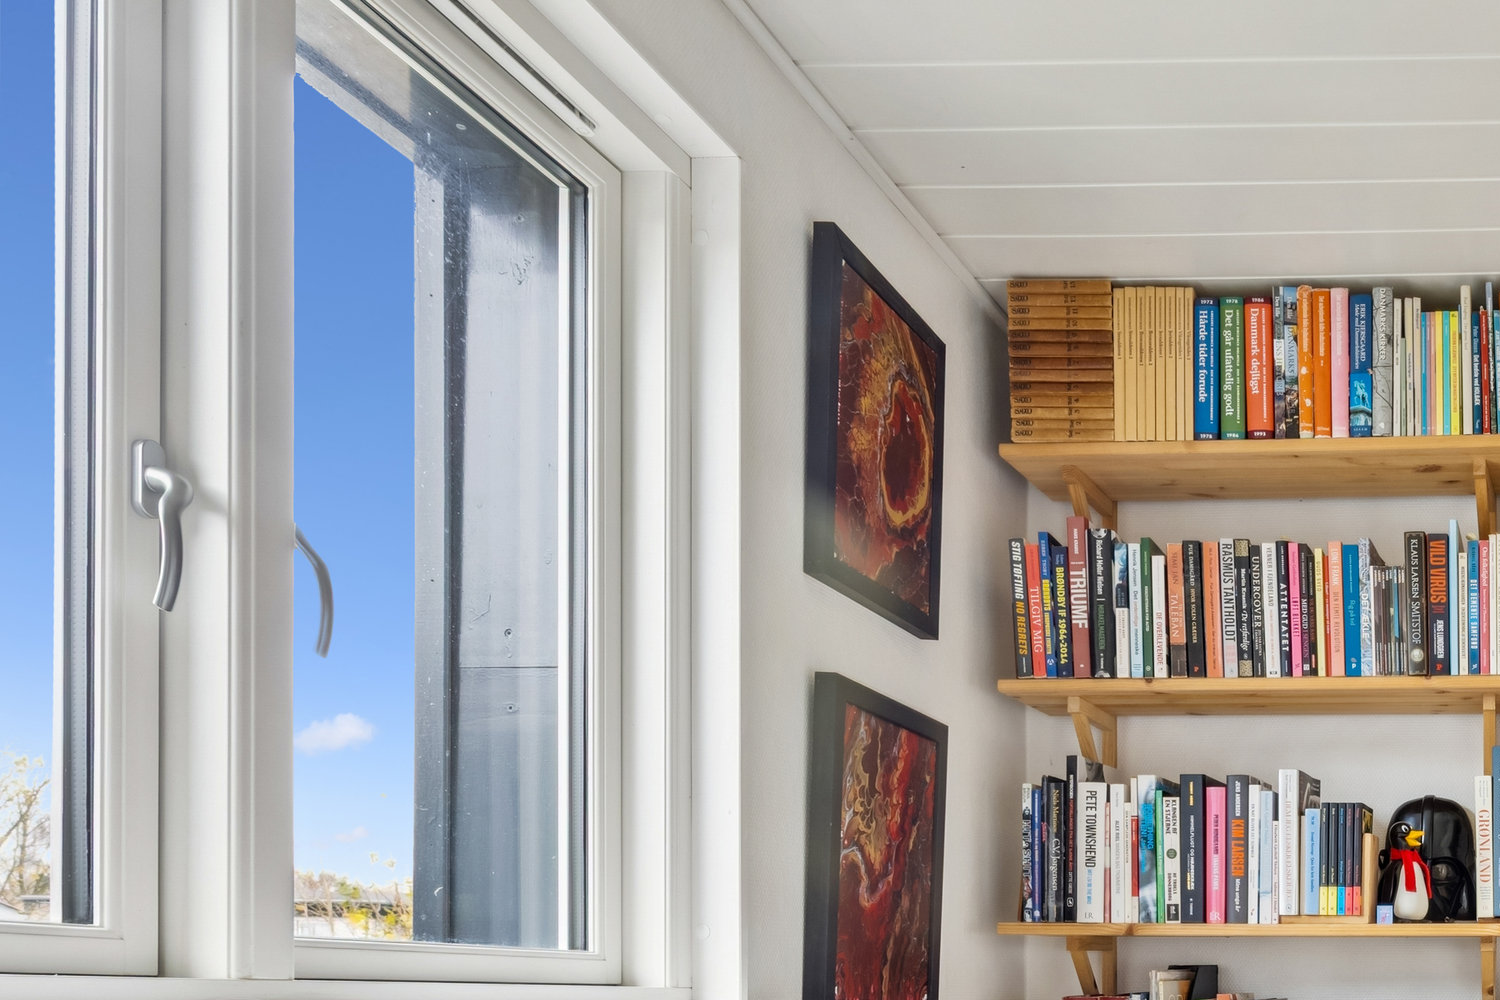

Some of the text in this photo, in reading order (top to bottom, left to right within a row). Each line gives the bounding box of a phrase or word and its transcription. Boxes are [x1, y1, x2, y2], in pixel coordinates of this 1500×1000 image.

[1199, 310, 1209, 403] Hårde tider forude
[1223, 309, 1236, 416] Det går ufattelig godt
[1250, 308, 1261, 394] Danmark dejligst
[1012, 541, 1024, 600] STIG TØFTING
[1096, 540, 1104, 558] Richard
[1410, 539, 1419, 598] KLAUS LARSEN
[1430, 540, 1447, 603] VILD VIRUS
[1056, 567, 1066, 607] BRØNDBY
[1070, 568, 1088, 629] TRIUMF
[1171, 594, 1179, 638] TALEBAN
[1222, 543, 1235, 642] RASMUS TANTHOLDT
[1252, 556, 1262, 628] UNDERCOVER
[1015, 601, 1028, 655] NO REGRETS
[1030, 586, 1042, 653] TILGIV MIG
[1058, 619, 1069, 665] 1964-2014
[1156, 612, 1164, 665] DE OVERLEVENDE
[1280, 583, 1289, 652] ATTENTATET
[1412, 601, 1421, 645] SMITSTOF
[1085, 790, 1097, 868] PETE TOWNSHEND
[1231, 819, 1245, 877] KIM LARSEN
[1478, 809, 1491, 883] GRØNLAND
[1050, 855, 1061, 891] Jørgensen
